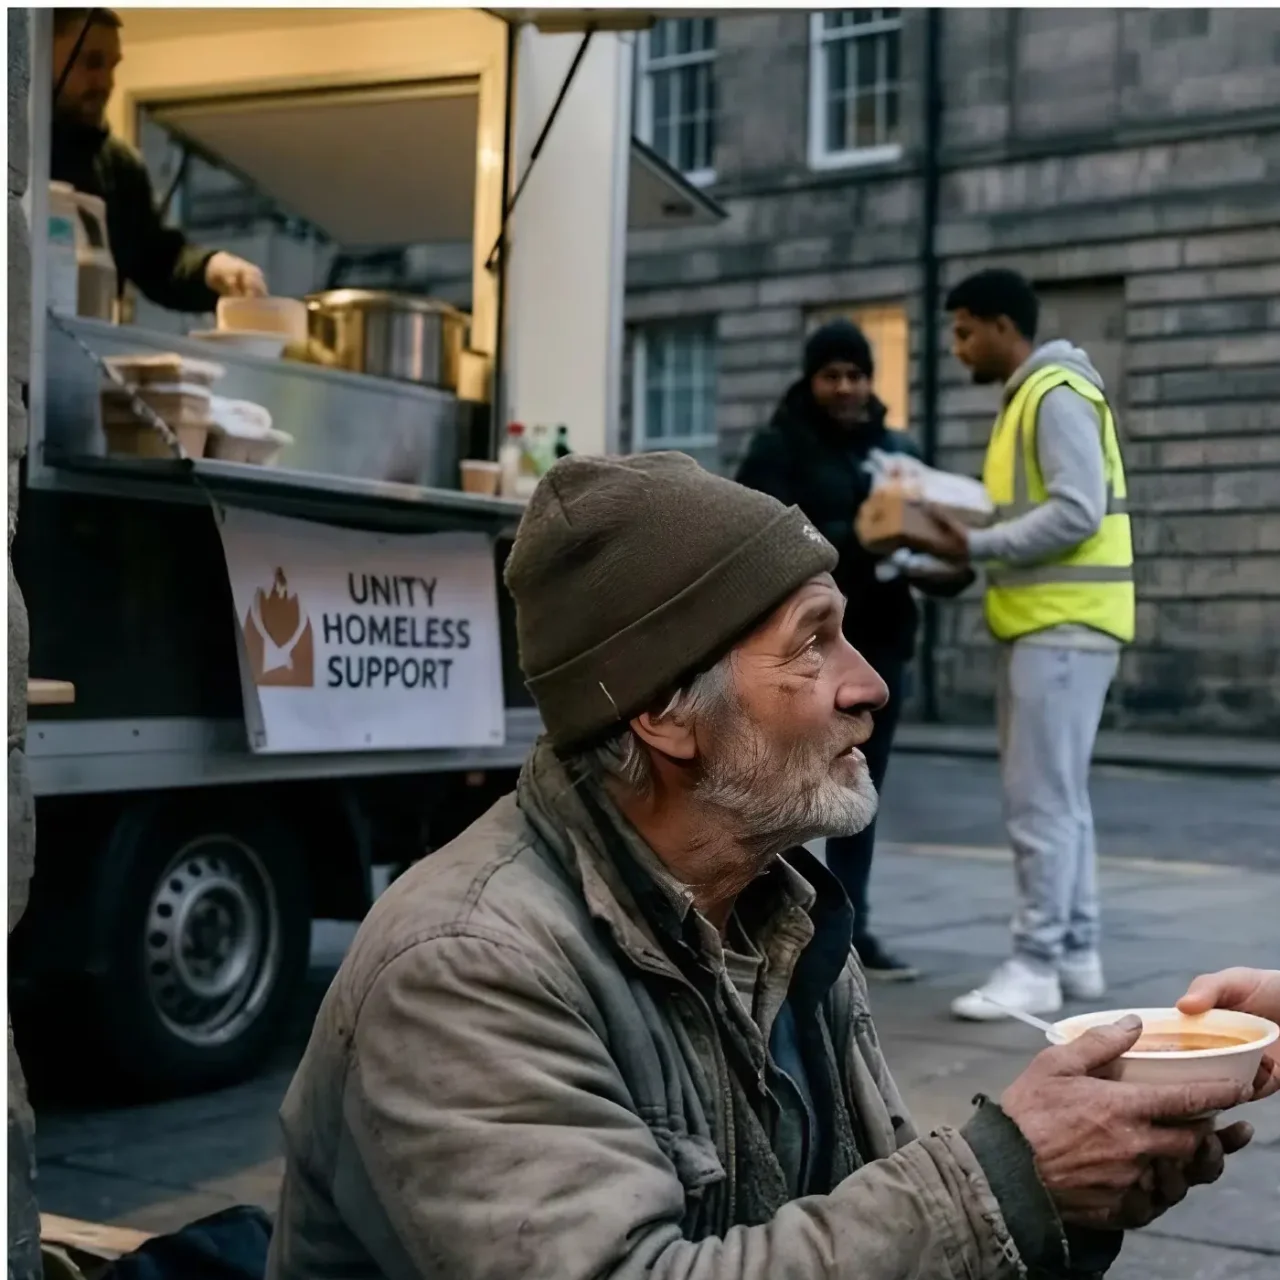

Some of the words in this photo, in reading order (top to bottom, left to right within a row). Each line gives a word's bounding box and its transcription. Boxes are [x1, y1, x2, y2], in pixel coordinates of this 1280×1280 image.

[348, 571, 438, 607] UNITY
[322, 612, 471, 649] HOMELESS
[327, 654, 453, 689] SUPPORT
